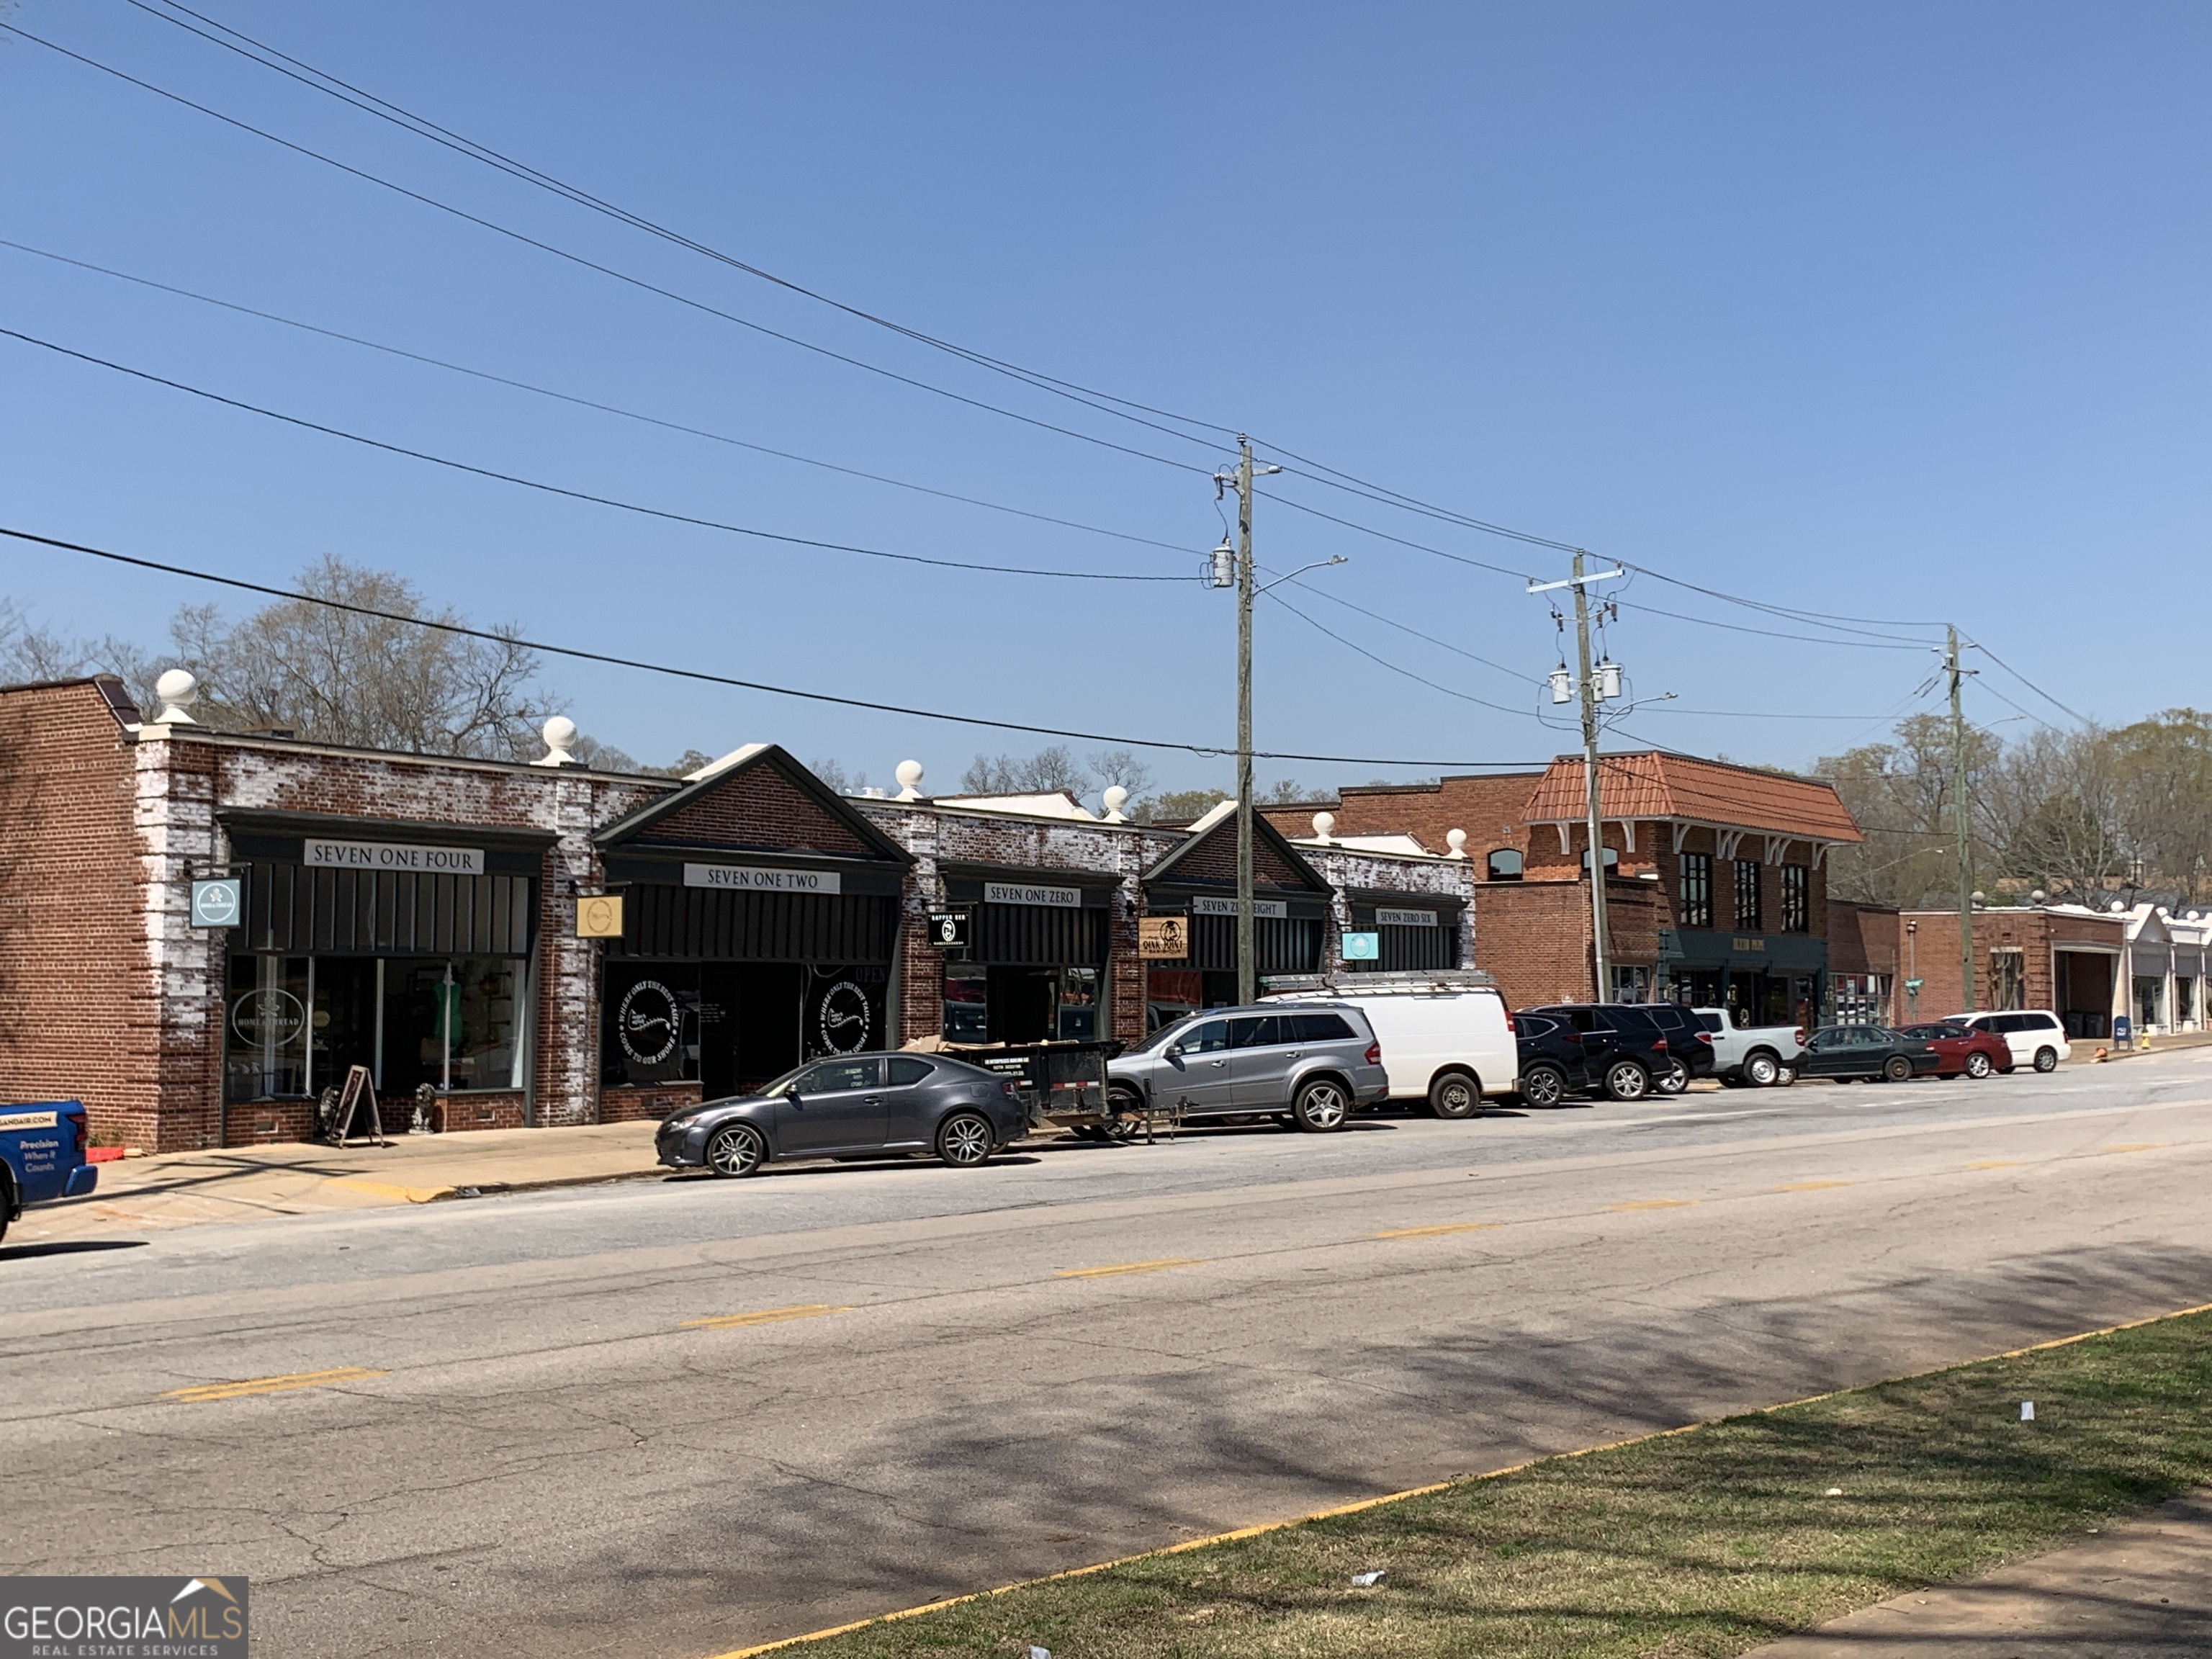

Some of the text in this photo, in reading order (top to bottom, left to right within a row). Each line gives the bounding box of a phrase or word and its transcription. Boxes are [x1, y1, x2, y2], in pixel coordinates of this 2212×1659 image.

[315, 845, 472, 868] SEVEN ONE FOUR
[708, 869, 818, 889] SEVEN ONE TWO
[991, 886, 1074, 903] SEVEN ONE ZERO
[1202, 900, 1228, 912] SEVEN
[1254, 903, 1277, 914] EIGHT
[1380, 912, 1431, 923] SEVEN ZERO SIX
[855, 967, 886, 983] OPEN
[619, 992, 633, 1022] WHERE
[631, 981, 647, 996] ONLY
[647, 981, 661, 991] THE
[660, 986, 674, 1003] BEST
[670, 1002, 679, 1028] TAILS
[820, 992, 832, 1021] WHERE
[830, 982, 842, 996] ONLY
[843, 981, 855, 991] THE
[853, 985, 866, 1001] BEST
[619, 1032, 675, 1065] COME TO OUR SHORE
[821, 1030, 834, 1051] COME
[19, 1139, 59, 1150] Precision
[24, 1151, 48, 1160] When
[25, 1163, 55, 1172] Counts
